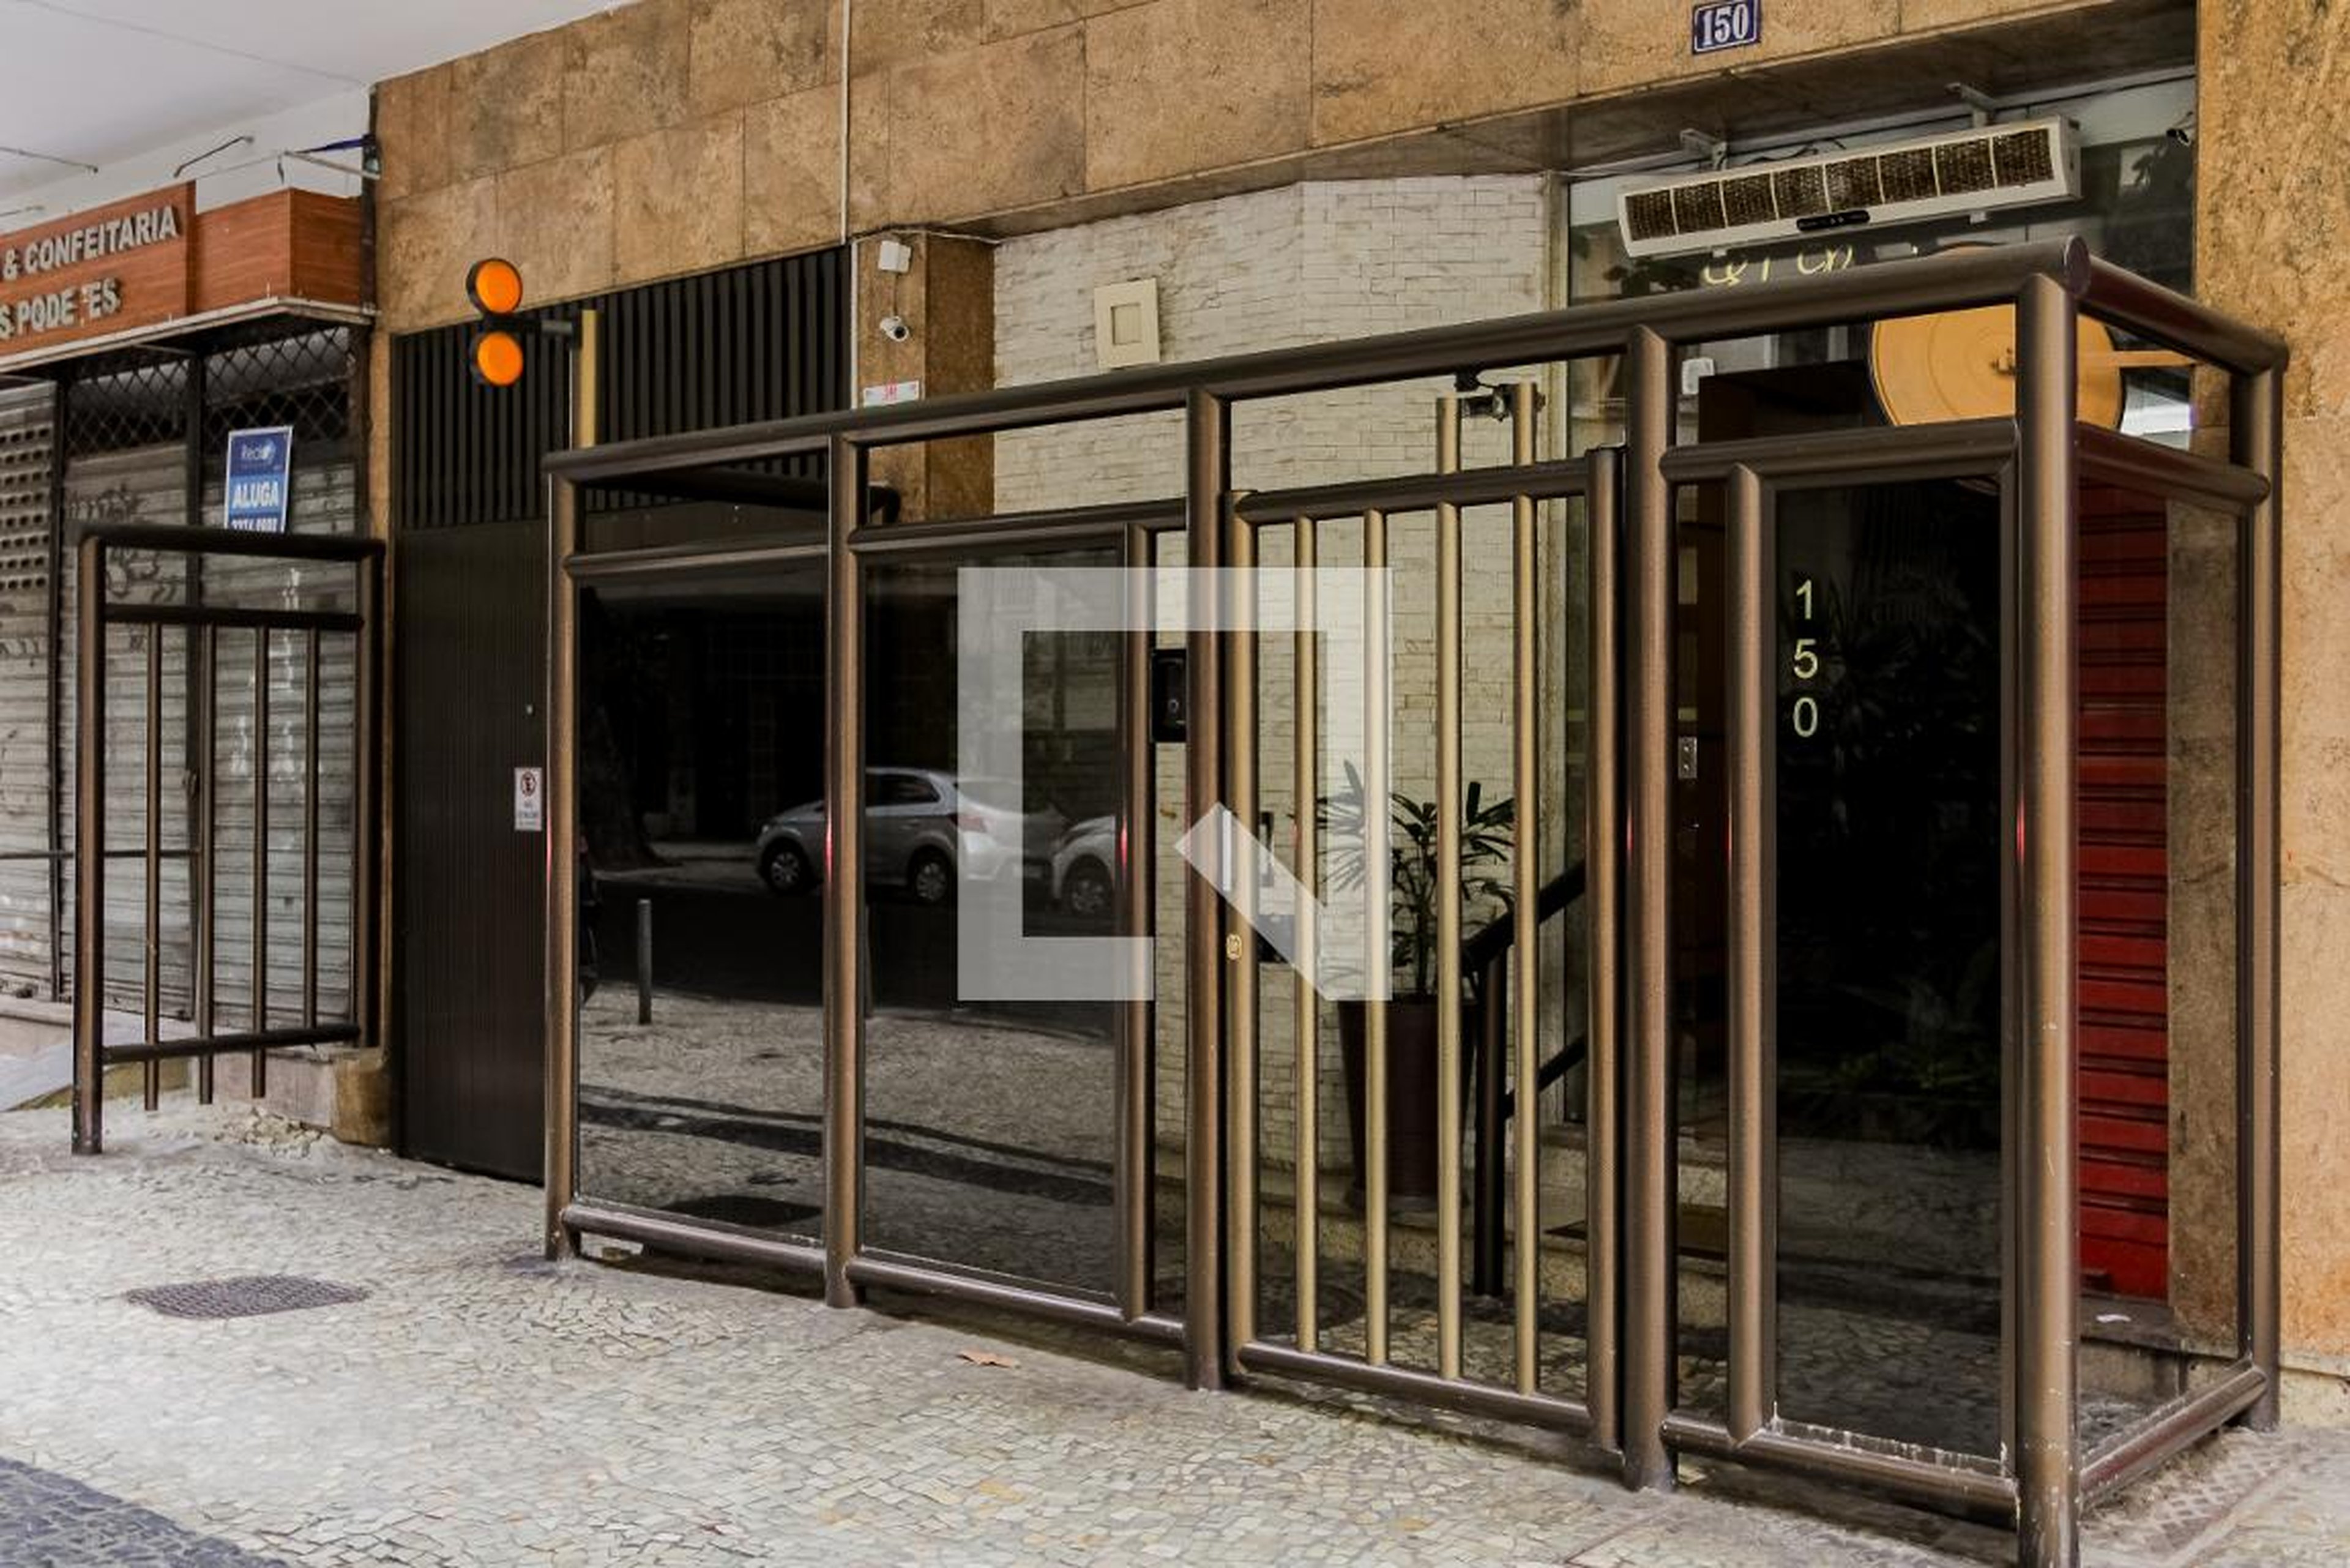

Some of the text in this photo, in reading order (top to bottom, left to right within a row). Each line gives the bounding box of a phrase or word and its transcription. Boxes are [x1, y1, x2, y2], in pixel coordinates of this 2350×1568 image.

[1701, 3, 1749, 47] 150
[2, 204, 179, 282] & CONFEITARIA
[231, 480, 278, 509] ALUGA
